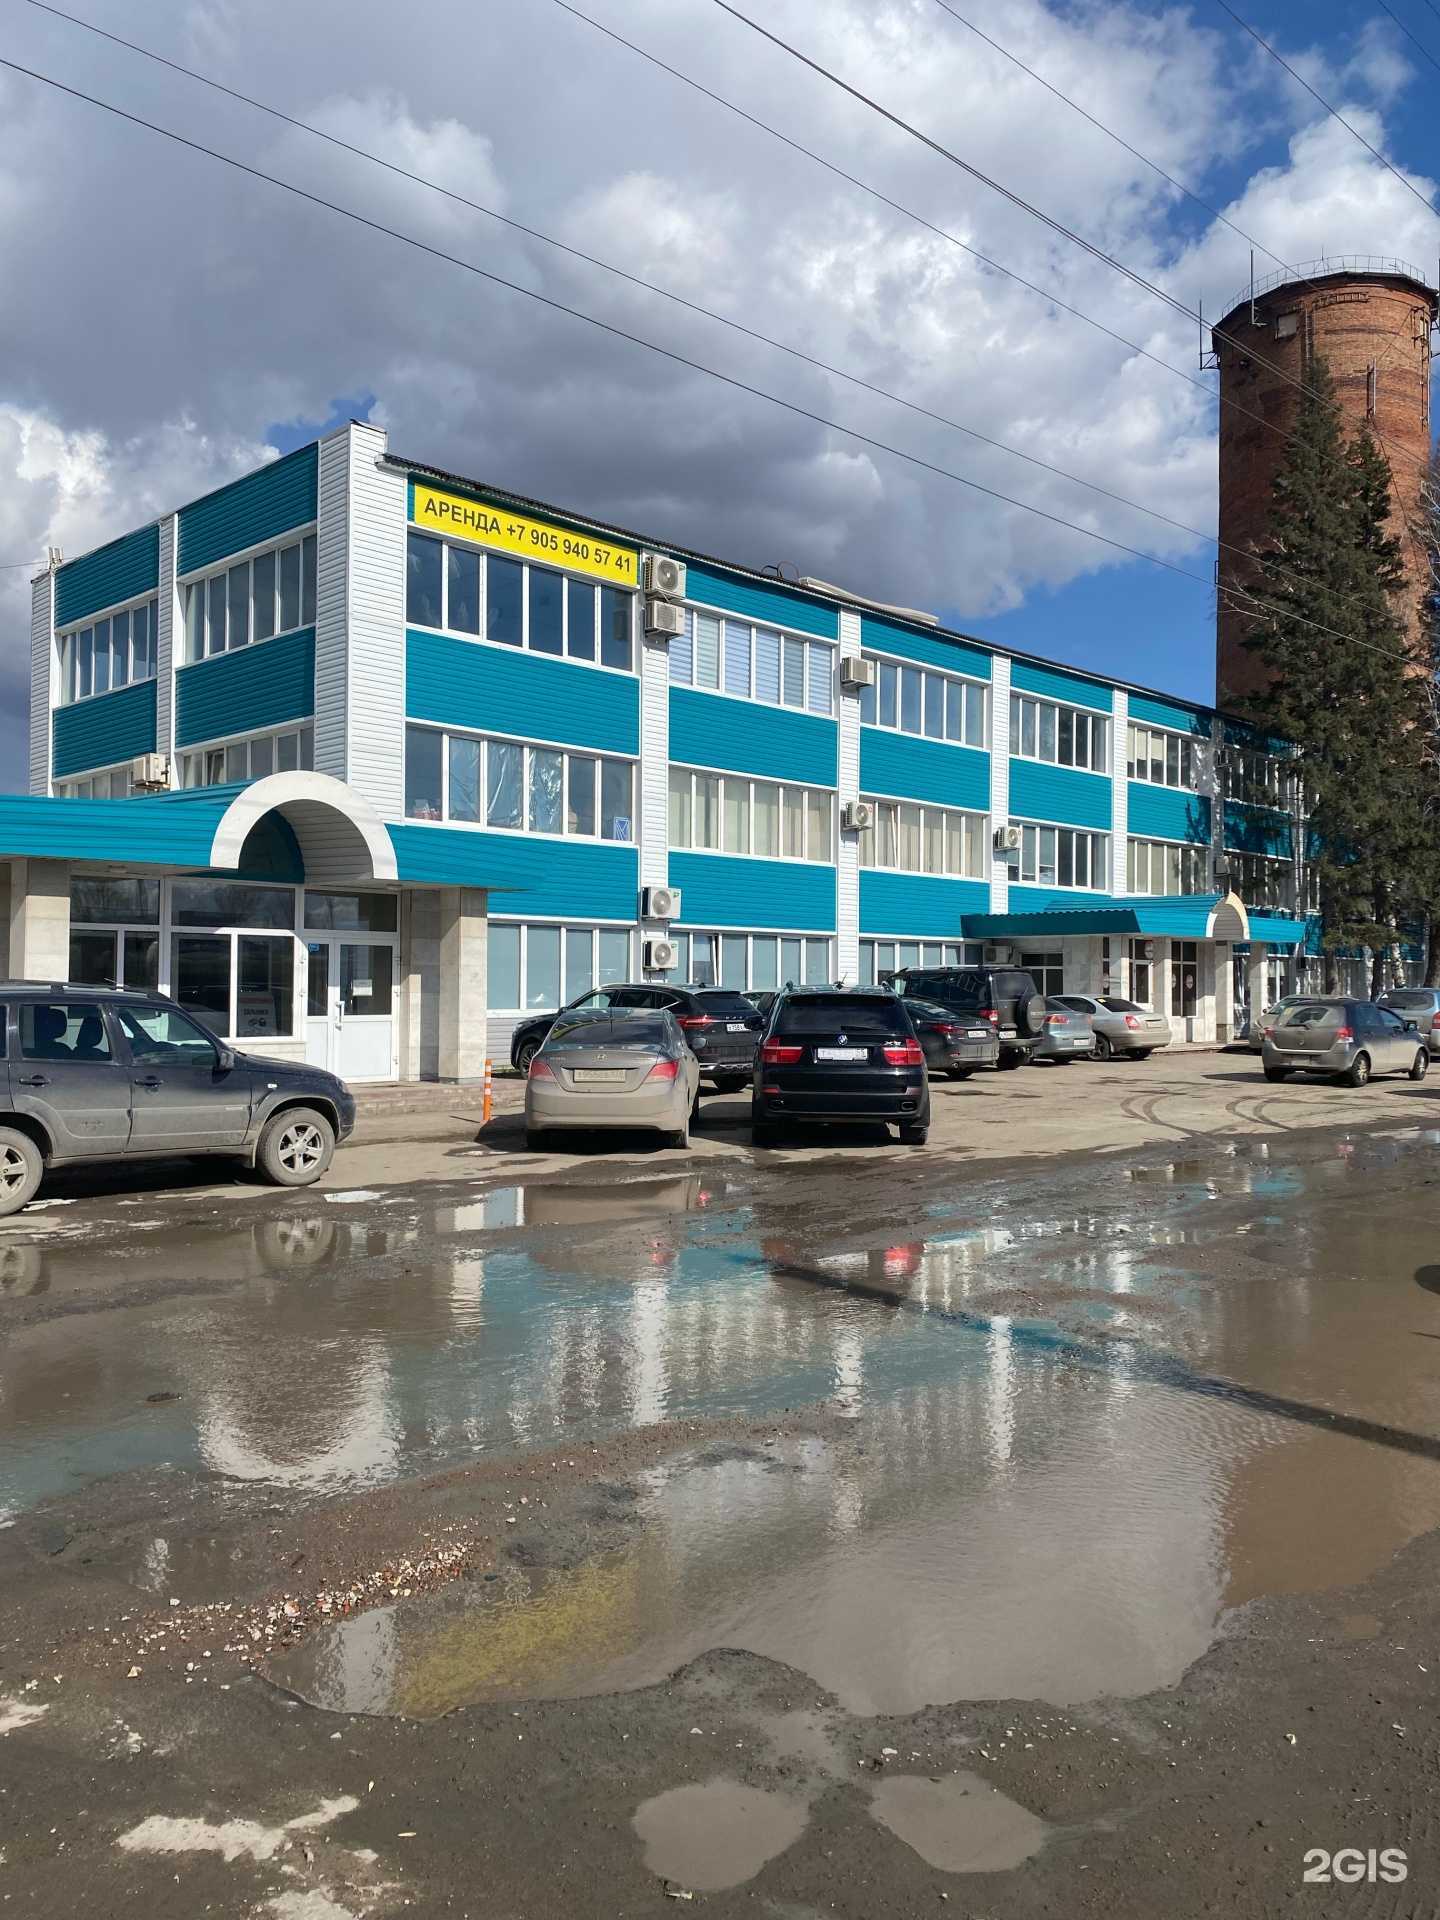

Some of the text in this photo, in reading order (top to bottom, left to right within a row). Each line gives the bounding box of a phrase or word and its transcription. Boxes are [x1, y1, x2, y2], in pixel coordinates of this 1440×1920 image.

[424, 498, 631, 572] АРЕНДА +7 905 940 57 41
